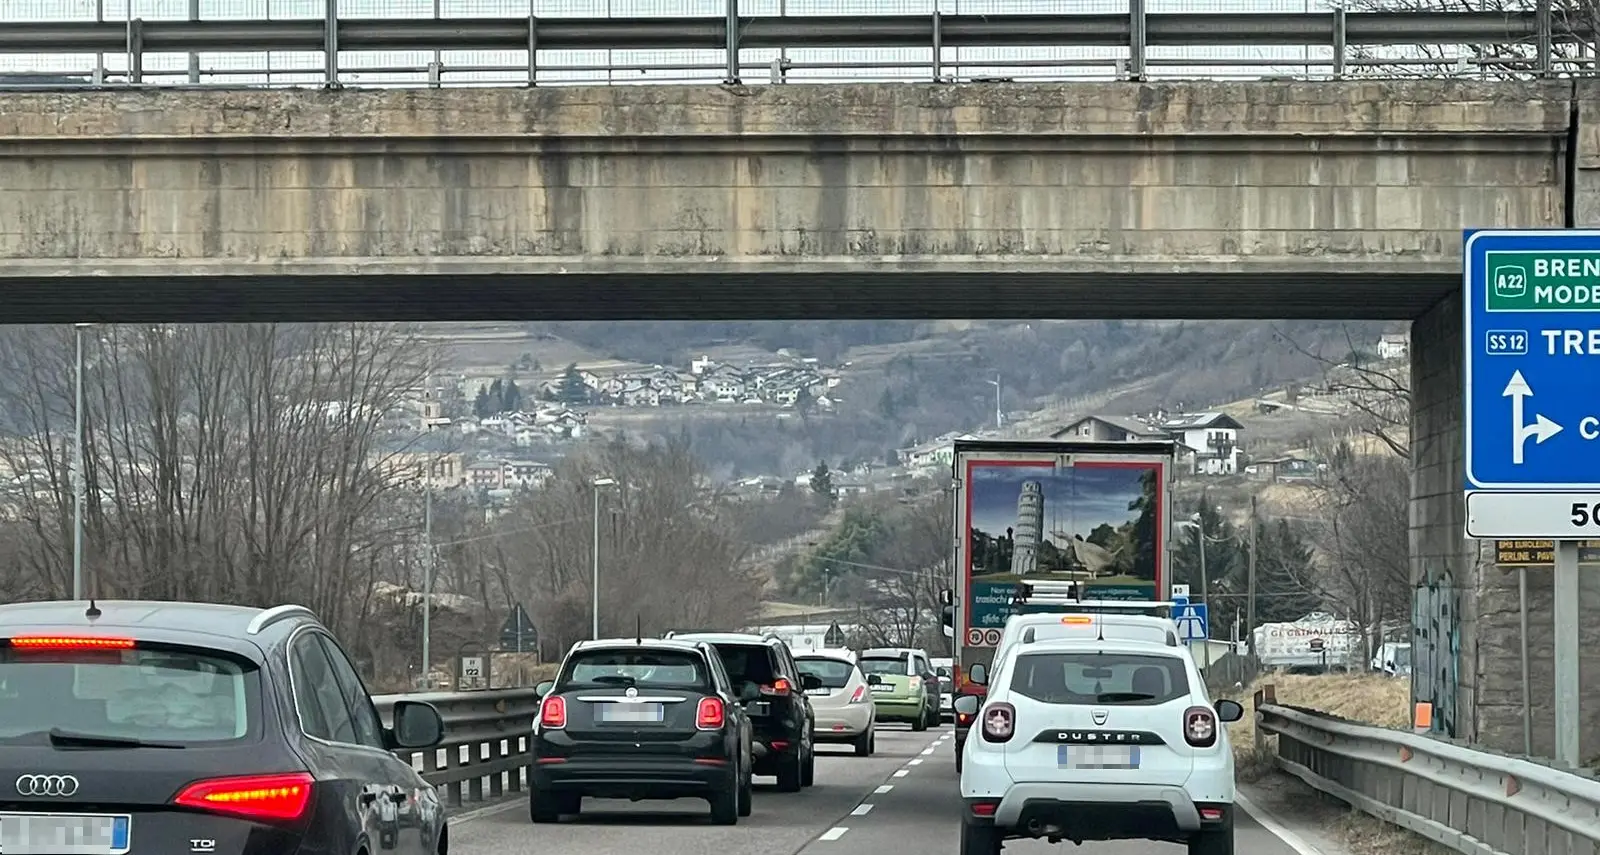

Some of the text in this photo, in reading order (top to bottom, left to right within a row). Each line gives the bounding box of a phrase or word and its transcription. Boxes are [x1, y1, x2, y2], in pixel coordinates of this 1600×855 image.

[1498, 274, 1523, 289] A22
[1490, 335, 1524, 350] SS 12
[1058, 732, 1140, 740] DUSTER
[190, 839, 215, 848] TDI
